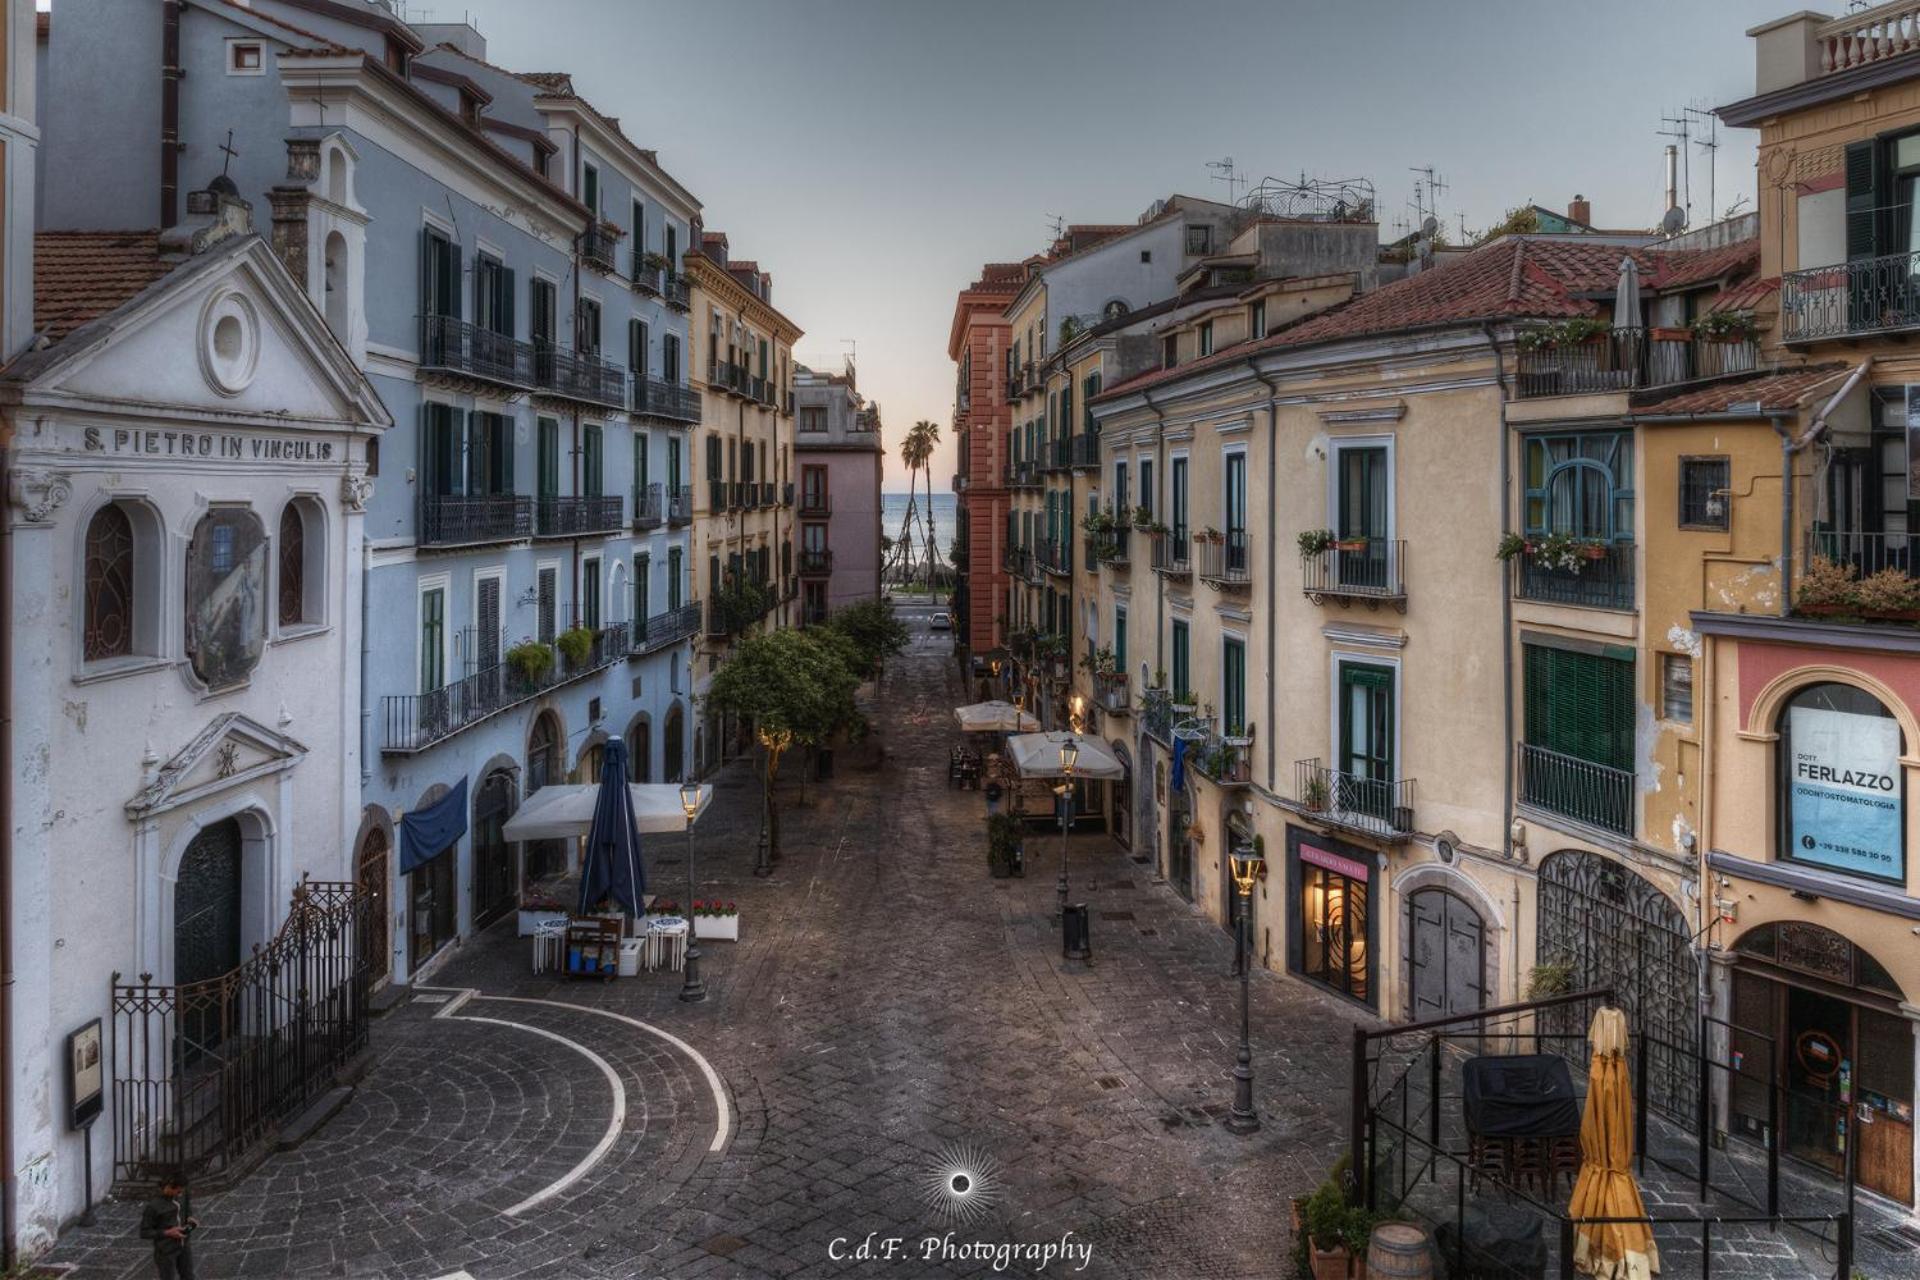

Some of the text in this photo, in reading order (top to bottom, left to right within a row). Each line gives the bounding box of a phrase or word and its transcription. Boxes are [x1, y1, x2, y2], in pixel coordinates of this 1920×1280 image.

[84, 427, 333, 461] S. PIETRO IN VINCULIS
[1798, 763, 1894, 791] FERLAZZO
[1796, 787, 1896, 810] ODONTOSTOMATOLOGIA
